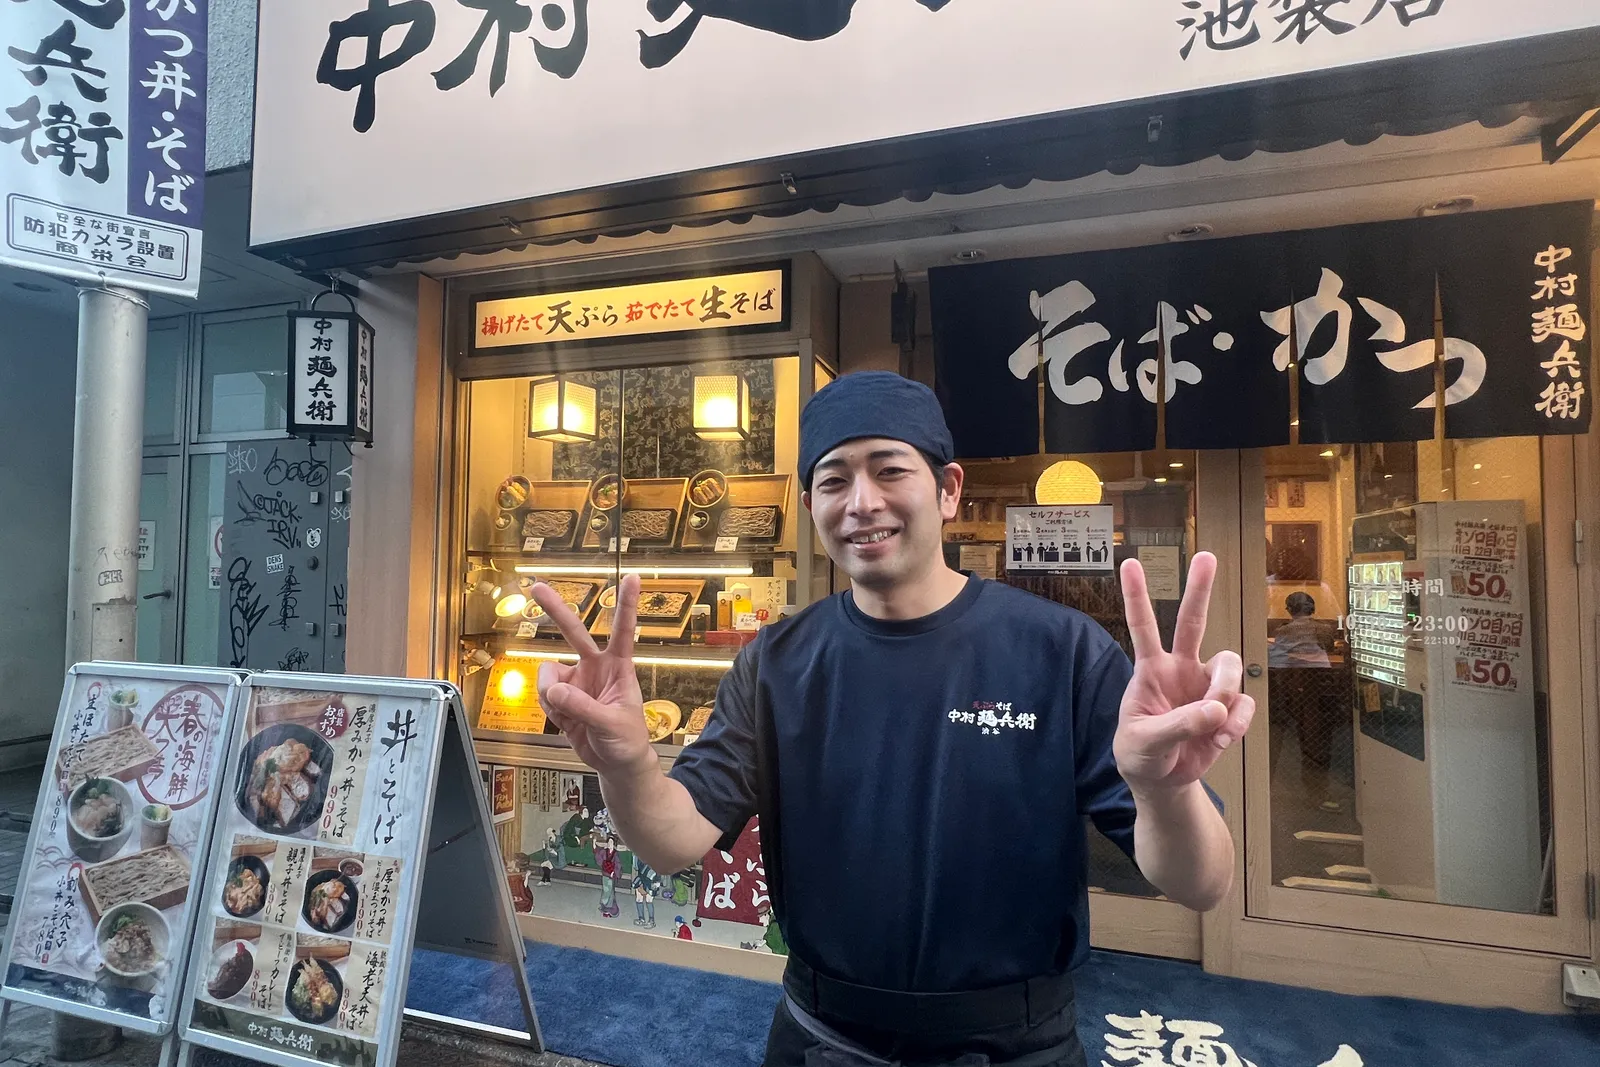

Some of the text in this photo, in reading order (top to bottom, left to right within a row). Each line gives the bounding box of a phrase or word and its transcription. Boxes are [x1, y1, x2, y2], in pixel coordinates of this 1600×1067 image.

[0, 0, 126, 184] 兵衛
[24, 216, 175, 260] 防犯カメラ設置
[55, 240, 148, 268] 商栄会
[56, 212, 151, 240] 安全な街宣言
[1530, 244, 1587, 420] 中村麺兵衛
[305, 317, 338, 421] 中村麺兵衛
[1028, 509, 1091, 519] セルフサービス
[164, 694, 207, 802] 春の海鮮
[336, 707, 346, 727] 店長
[947, 708, 1038, 730] 中村麺兵衛
[332, 706, 367, 838] 厚みかつ丼とそば
[374, 708, 418, 845] 丼とそば
[320, 785, 338, 839] 990円
[275, 847, 299, 923] 親子丼とそば
[376, 867, 394, 937] 厚みかつ丼と
[356, 951, 380, 1029] 海老天丼と
[247, 1021, 314, 1052] 中村麺兵衛
